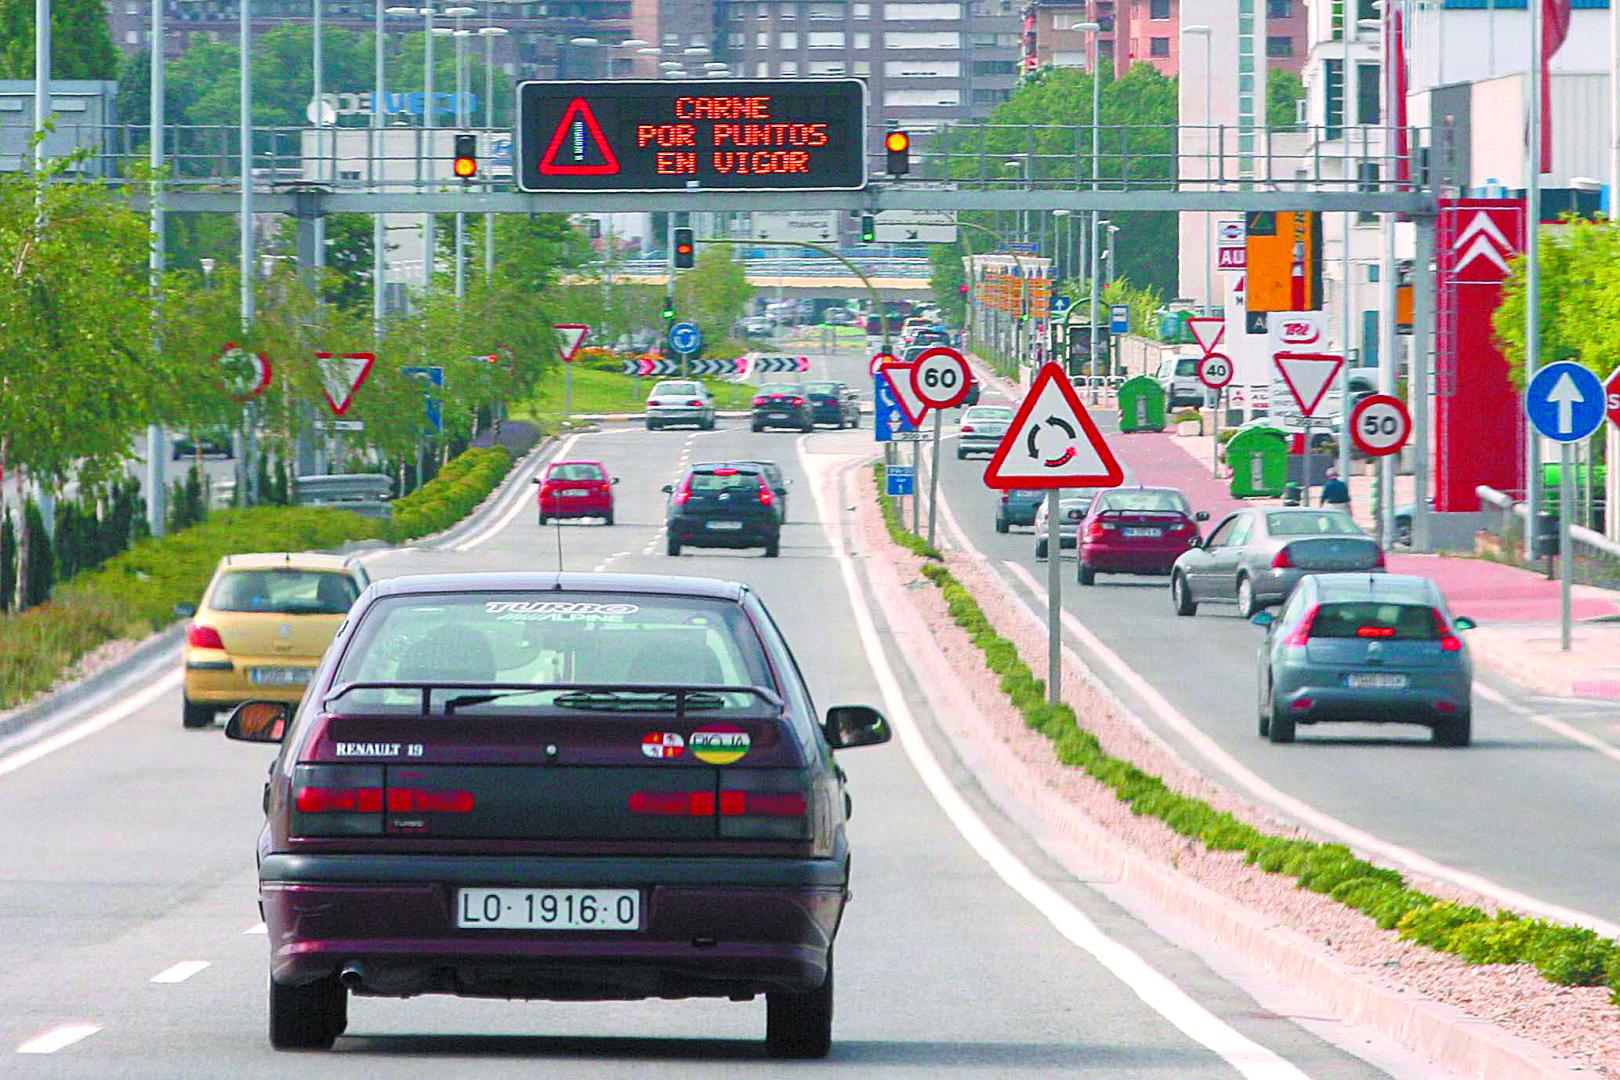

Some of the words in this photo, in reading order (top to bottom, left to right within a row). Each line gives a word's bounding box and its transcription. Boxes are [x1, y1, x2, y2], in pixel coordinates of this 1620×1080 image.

[675, 97, 771, 119] CARNE
[637, 124, 696, 146] POR
[713, 123, 828, 146] PUNTOS
[656, 151, 696, 174] EN
[712, 151, 809, 174] VIGOR
[924, 367, 957, 388] 60
[1206, 364, 1226, 377] 40
[1364, 415, 1398, 435] 50
[486, 601, 640, 614] TURBO
[336, 742, 401, 756] RENAULT
[408, 743, 424, 756] 19
